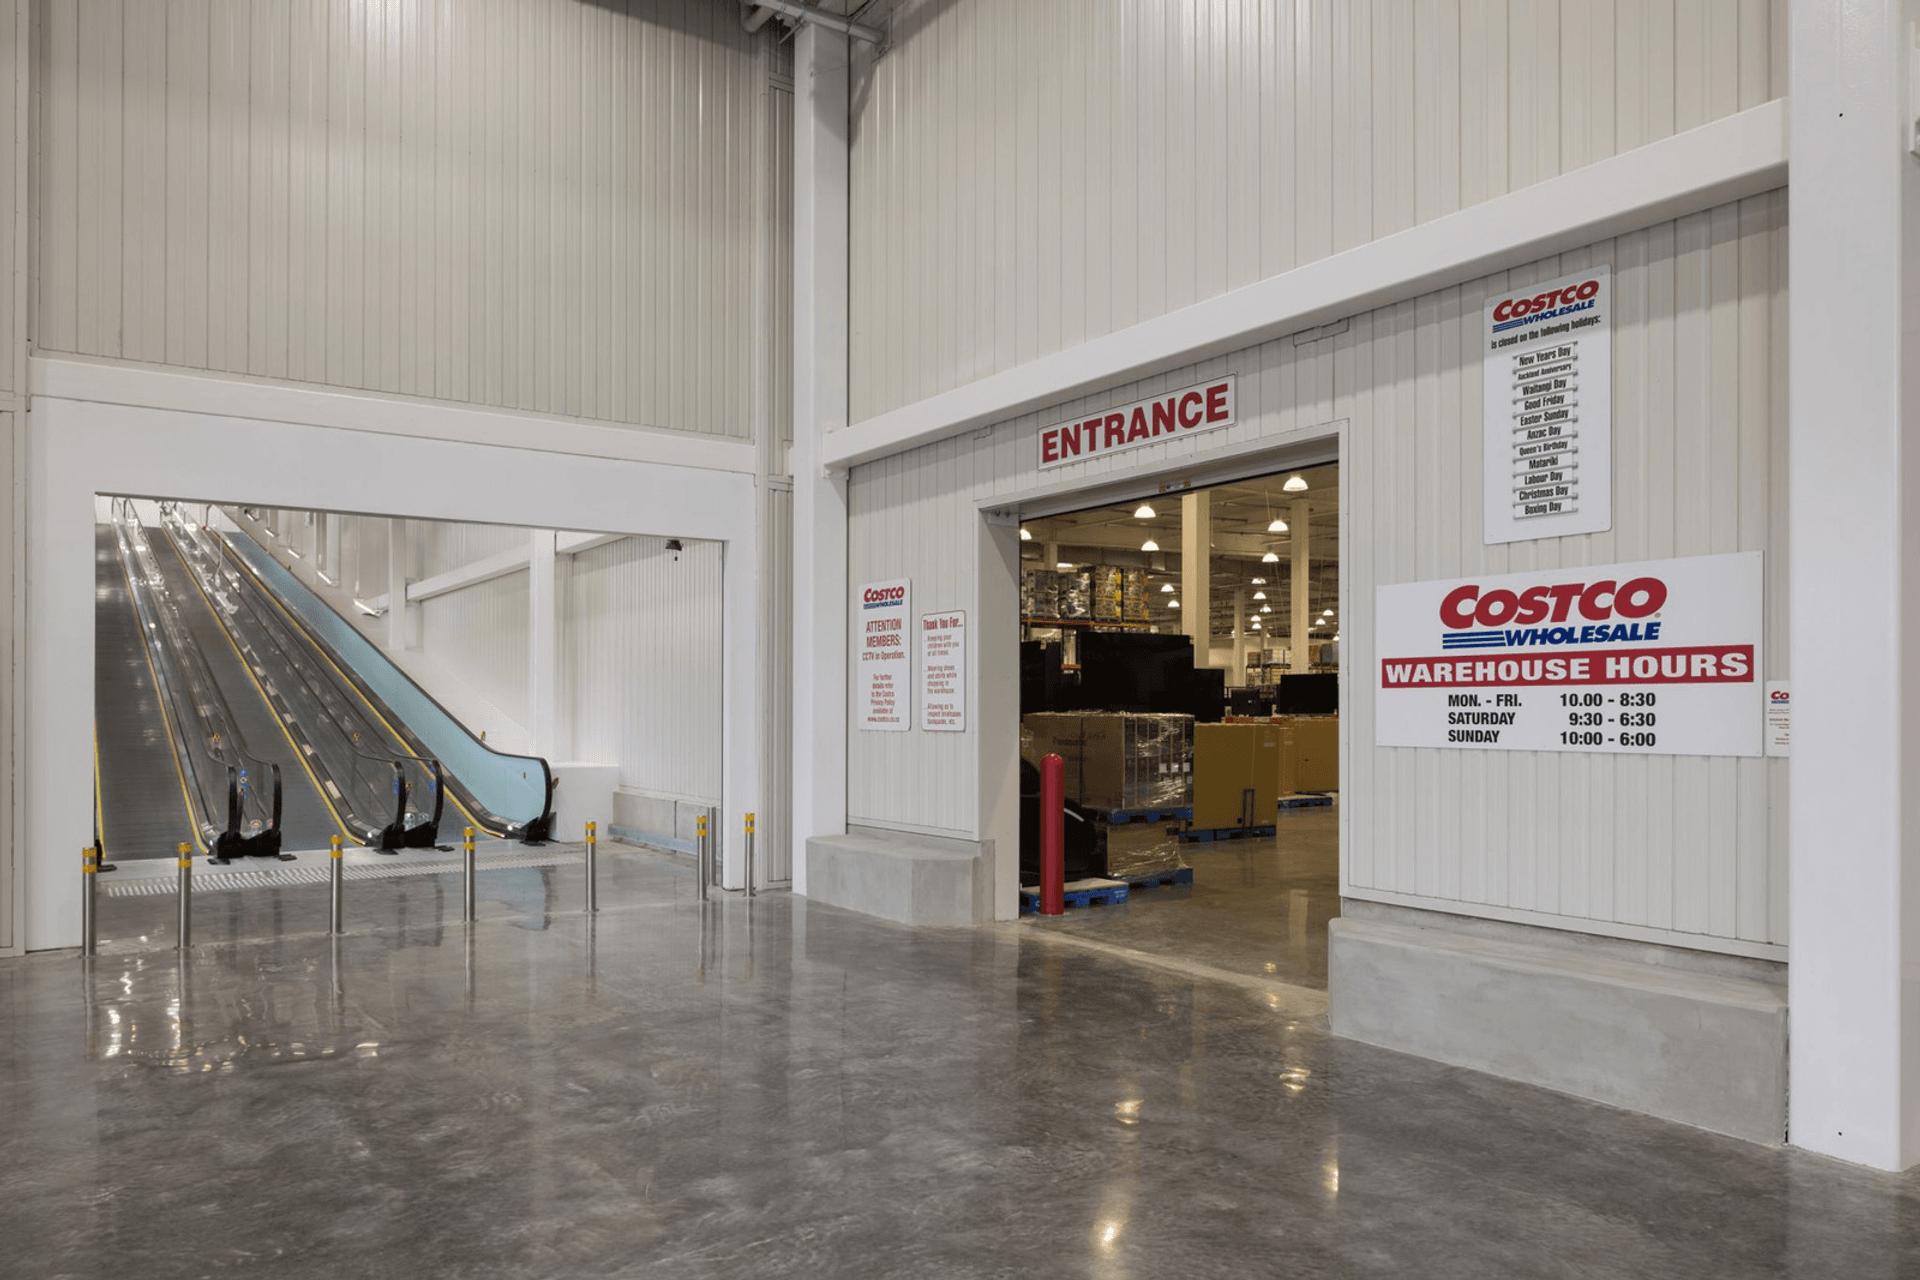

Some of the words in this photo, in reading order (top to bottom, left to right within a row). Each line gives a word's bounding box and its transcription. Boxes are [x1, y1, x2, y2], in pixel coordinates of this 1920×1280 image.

[1493, 280, 1599, 322] COSTCO
[1523, 299, 1595, 325] WHOLESALE
[1498, 334, 1518, 347] closed
[1520, 333, 1527, 342] on
[1529, 330, 1539, 339] the
[1541, 323, 1569, 337] following
[1571, 315, 1600, 329] holidays:
[1519, 356, 1535, 366] New
[1536, 350, 1556, 362] Years
[1558, 347, 1571, 357] Day
[1518, 369, 1539, 380] Auckland
[1541, 363, 1571, 375] Anniversary
[1522, 380, 1552, 396] Waitangi
[1554, 379, 1567, 389] Day
[1524, 398, 1540, 410] Good
[1542, 394, 1564, 407] Friday
[1042, 383, 1229, 463] ENTRANCE
[1520, 414, 1542, 426] Easter
[1543, 409, 1569, 421] Sunday
[1527, 429, 1546, 440] Anzac
[1548, 426, 1561, 436] Day
[1519, 444, 1542, 456] Queen's
[1543, 440, 1568, 452] Birthday
[1529, 456, 1558, 469] Matariki
[1524, 474, 1548, 485] Labour
[1550, 471, 1563, 481] Day
[1519, 487, 1553, 501] Christmas
[1555, 485, 1569, 496] Day
[1525, 504, 1547, 515] Boxing
[1549, 501, 1562, 512] Day
[864, 586, 905, 603] COSTCO
[1440, 577, 1667, 629] COSTCO
[866, 618, 902, 633] ATTENTION
[923, 619, 938, 631] Thank
[939, 617, 948, 629] You
[866, 633, 901, 648] MEMBERS:
[1504, 622, 1661, 647] WHOLESALE
[862, 651, 874, 661] CCTV
[1385, 658, 1591, 683] WAREHOUSE
[1605, 652, 1749, 679] HOURS
[1448, 694, 1481, 707] MON.
[1496, 694, 1522, 707] FRI.
[1560, 693, 1603, 707] 10.00
[1620, 692, 1656, 707] 8:30
[1448, 712, 1516, 725] SATURDAY
[1569, 712, 1603, 726] 9:30
[1620, 712, 1656, 726] 6:30
[1448, 730, 1500, 743] SUNDAY
[1560, 731, 1603, 745] 10:00
[1620, 732, 1656, 747] 6:00
